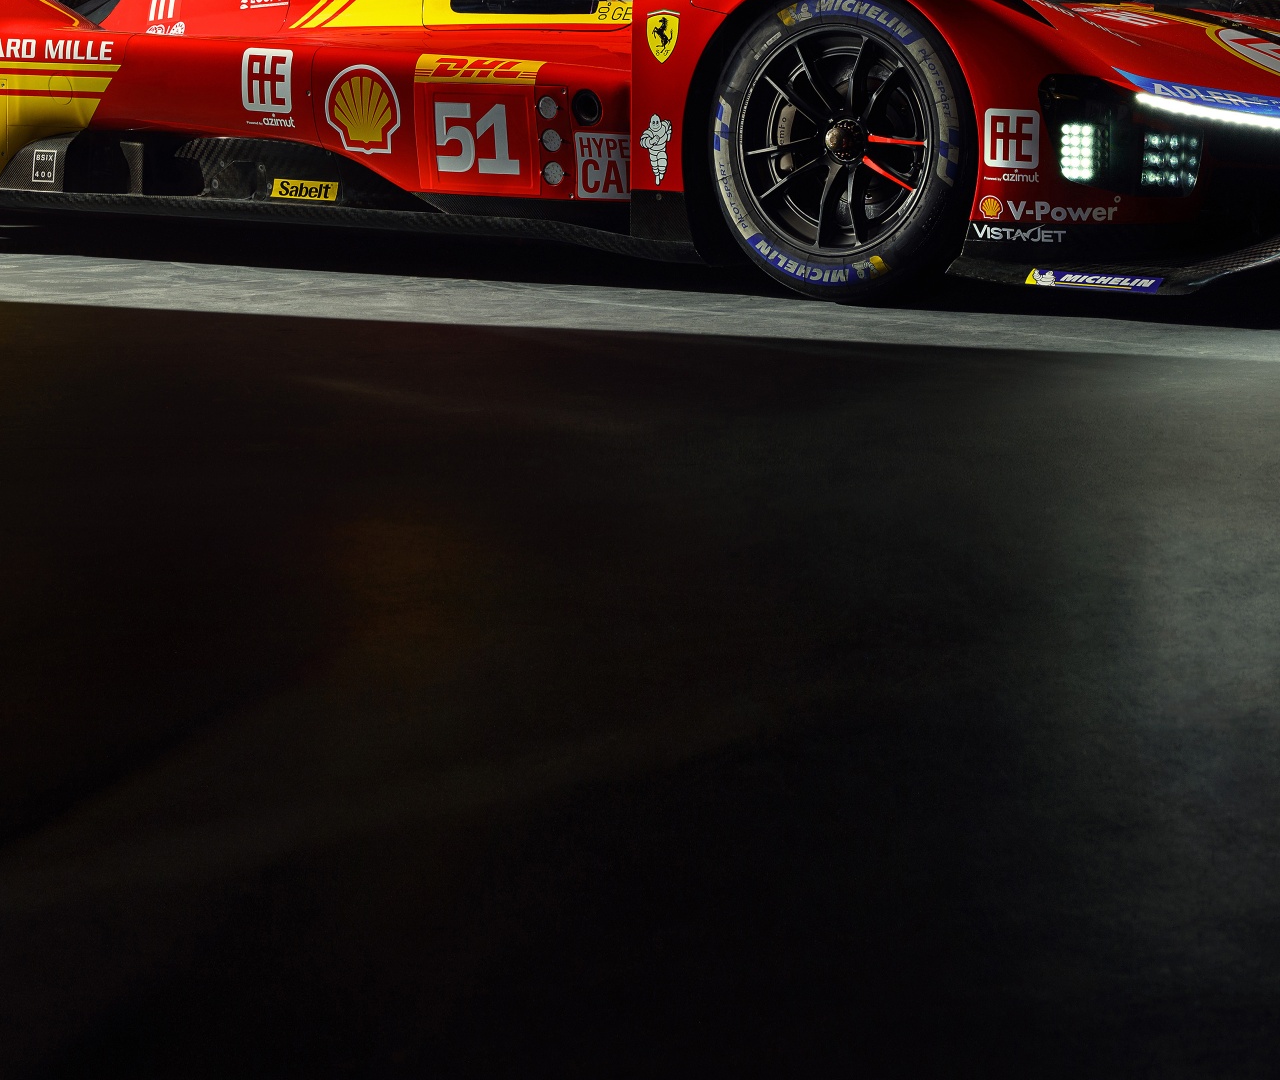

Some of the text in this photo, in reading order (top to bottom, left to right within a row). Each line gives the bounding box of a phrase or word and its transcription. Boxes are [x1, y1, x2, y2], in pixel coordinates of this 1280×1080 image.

[44, 39, 115, 62] MILLE
[430, 58, 522, 79] DHL
[917, 48, 951, 118] PILOT SPORT
[1151, 83, 1251, 108] ADLER
[263, 113, 296, 128] azimut
[434, 101, 520, 175] 51
[579, 136, 630, 159] HYPE
[34, 170, 53, 178] 400
[1002, 168, 1040, 183] azimut
[278, 180, 331, 199] Sabelt
[719, 163, 748, 229] PILOT SPORT
[1007, 200, 1118, 221] V-Power
[754, 238, 850, 283] MICHELIN
[1059, 273, 1156, 288] MICHELIN
